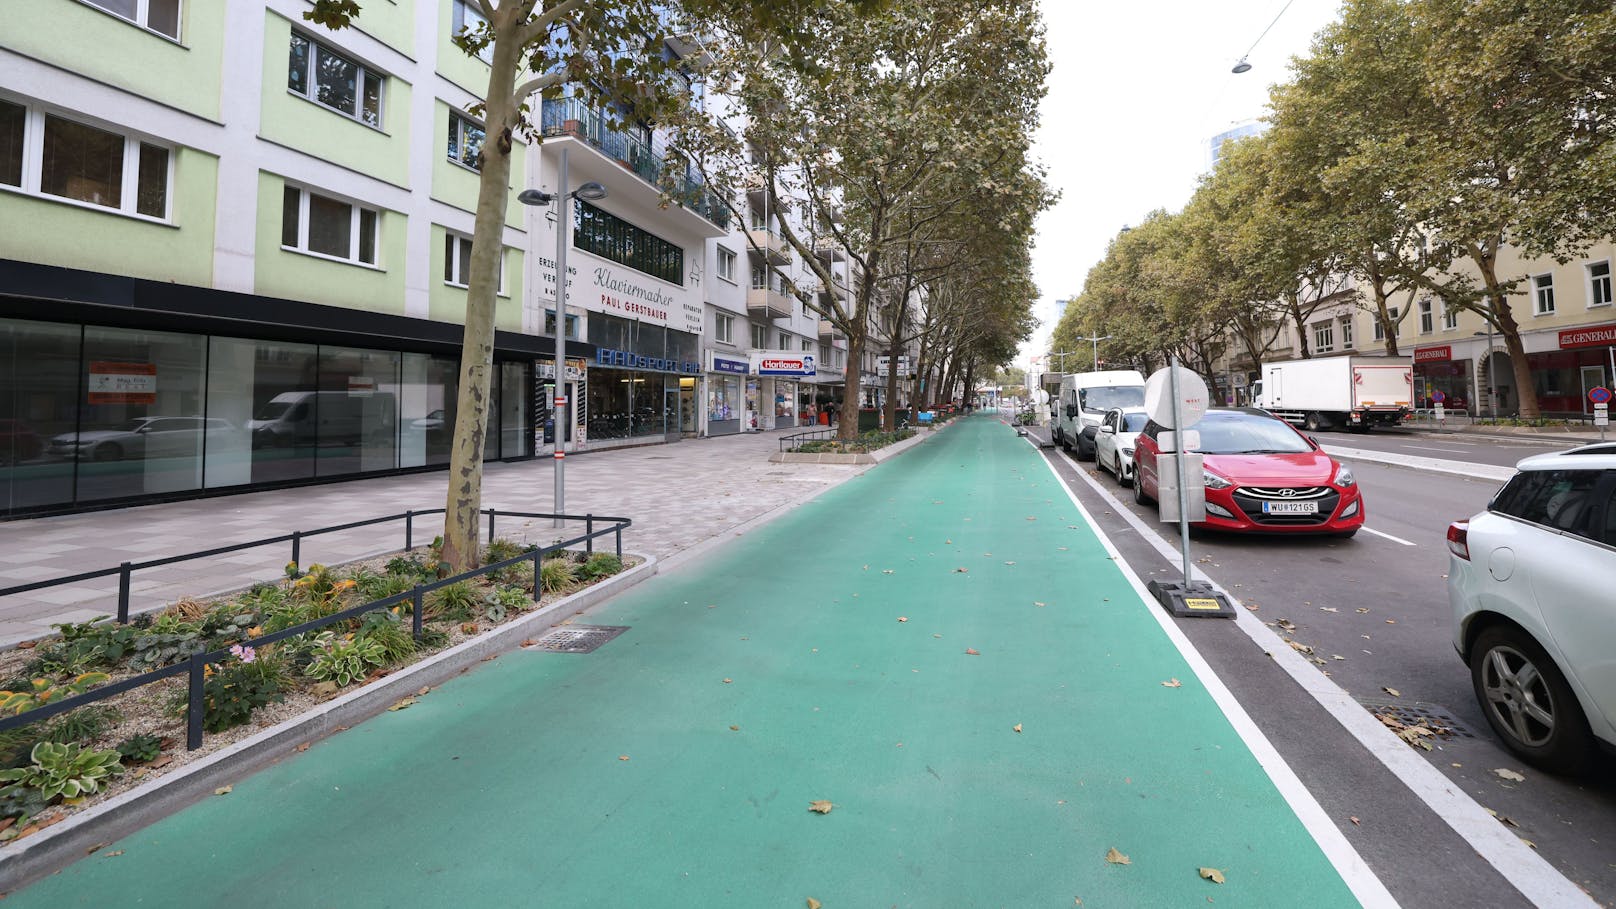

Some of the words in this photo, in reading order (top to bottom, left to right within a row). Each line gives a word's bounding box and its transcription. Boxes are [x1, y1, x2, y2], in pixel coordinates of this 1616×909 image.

[593, 267, 673, 306] Klaviermacher
[601, 294, 621, 309] PAUL
[624, 301, 668, 320] GERSTBAUER
[764, 360, 801, 369] Hartlauer
[1271, 503, 1283, 511] WU
